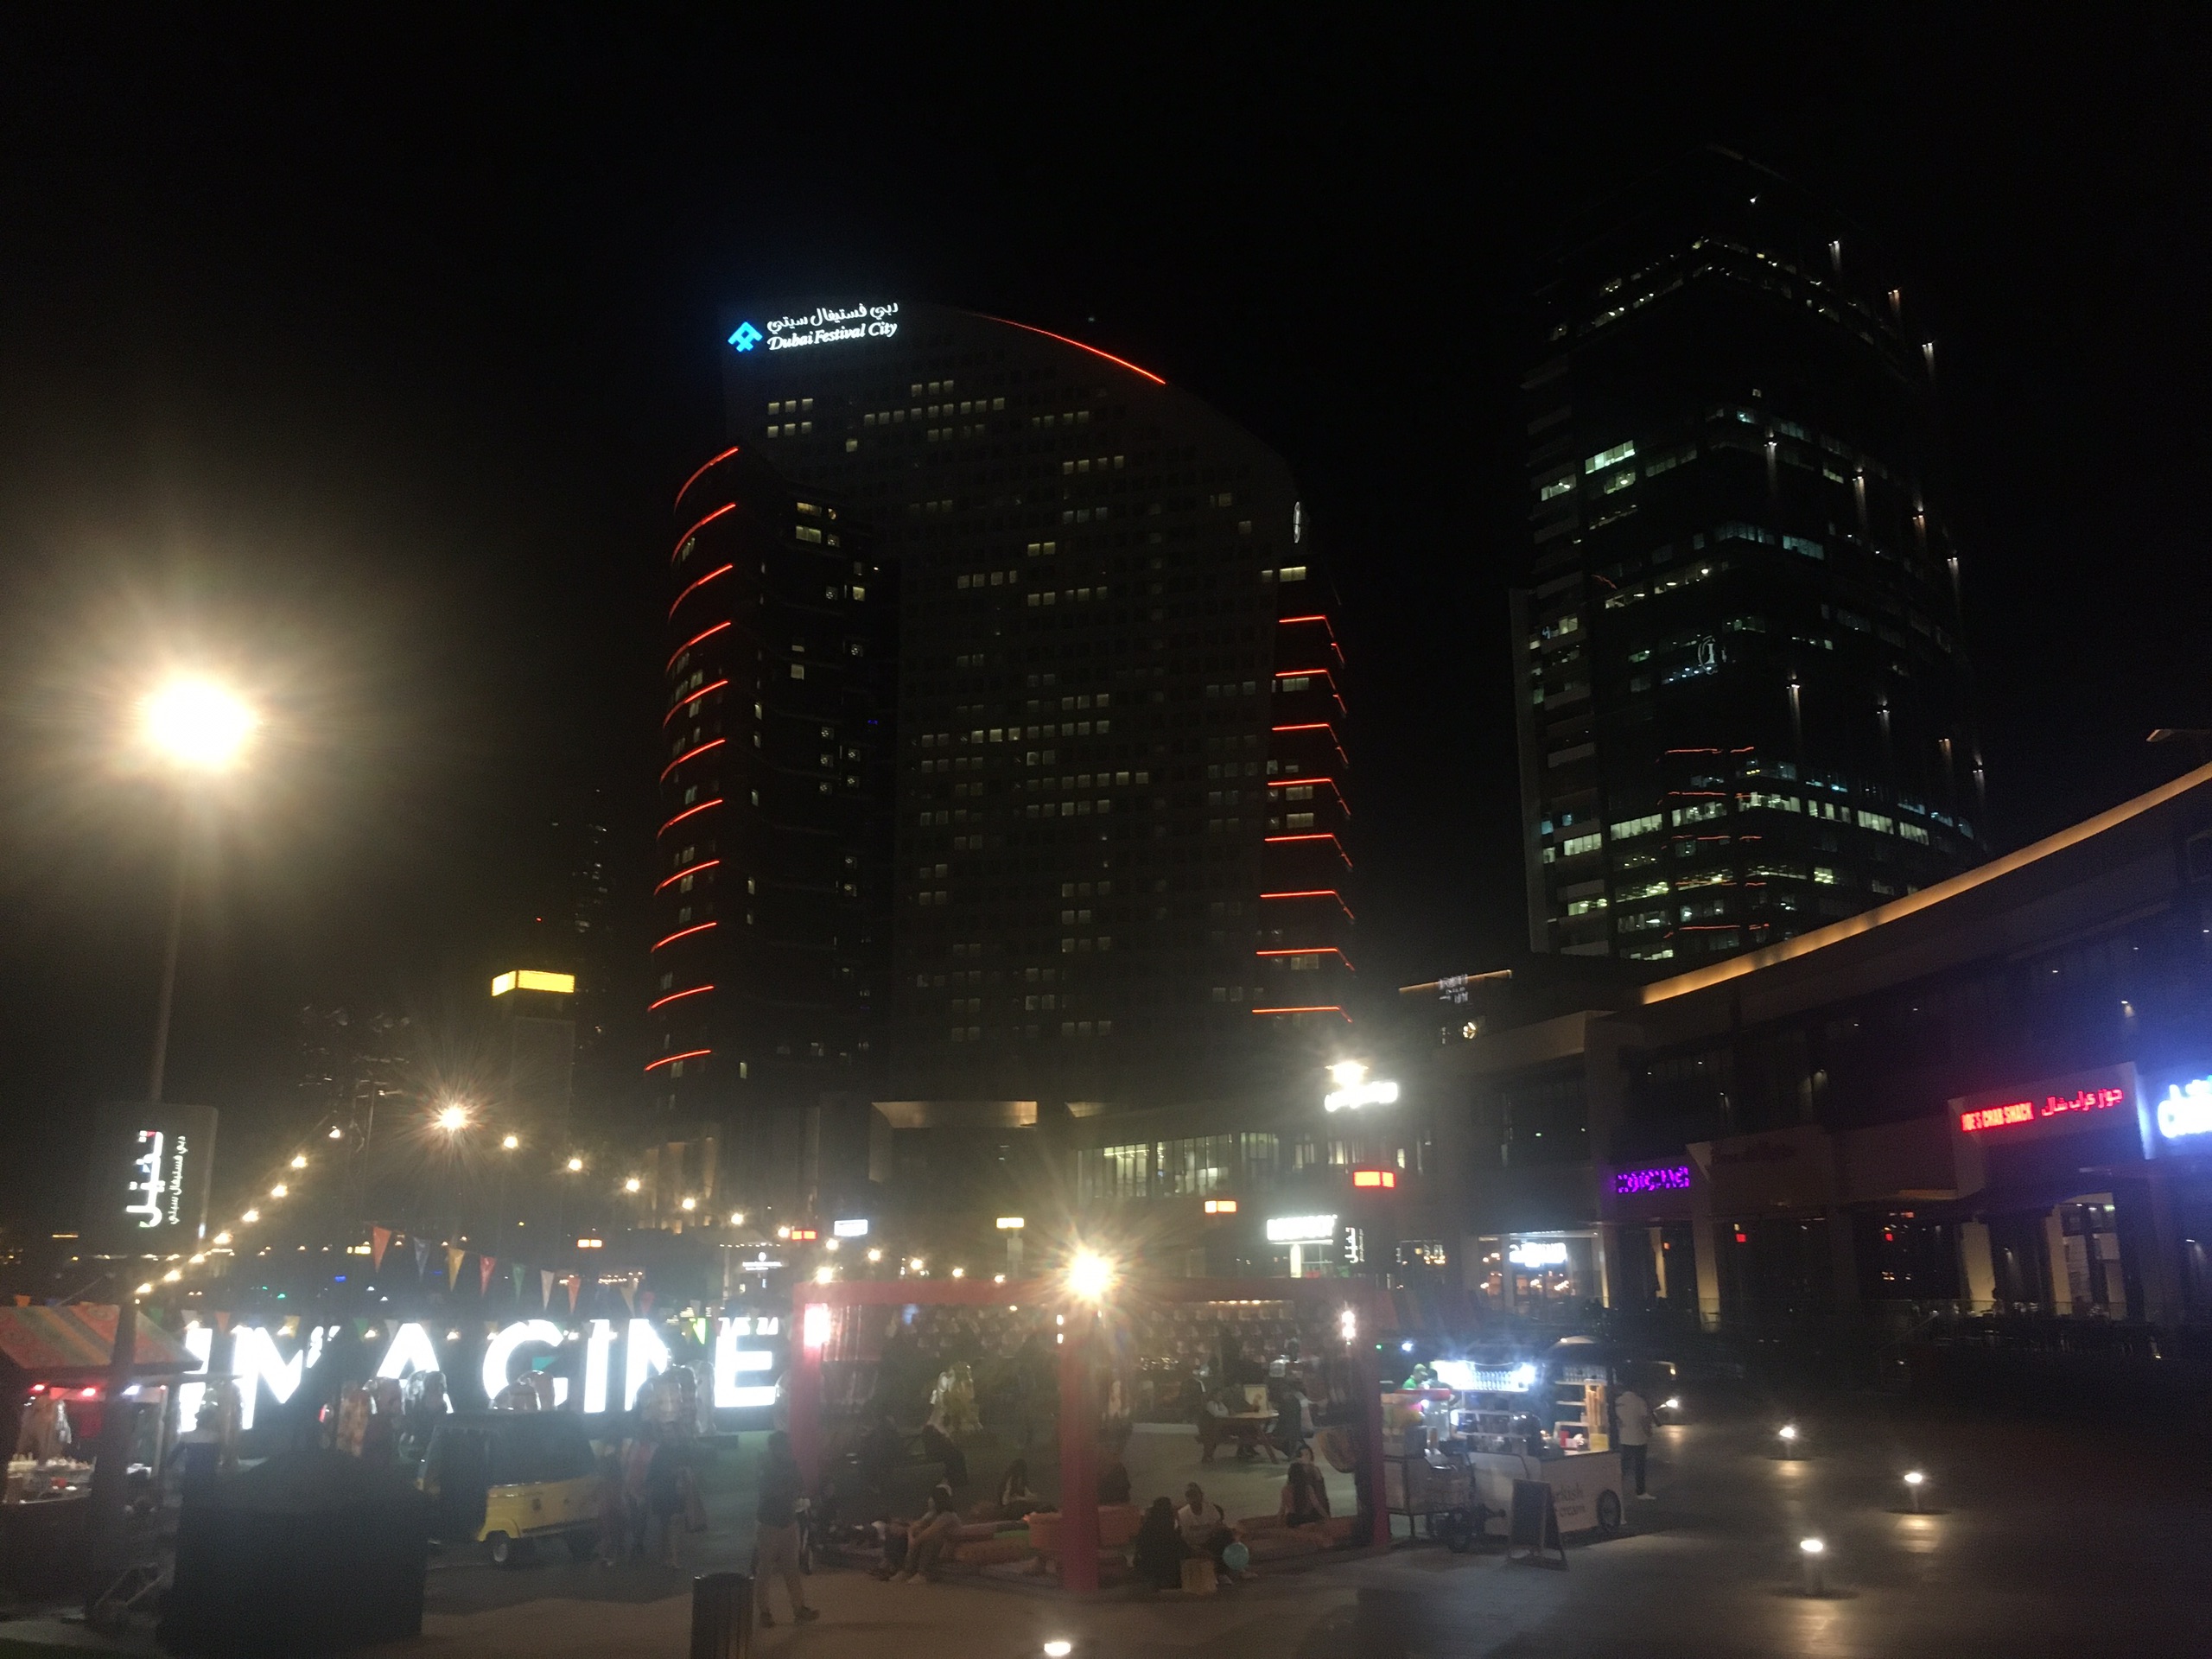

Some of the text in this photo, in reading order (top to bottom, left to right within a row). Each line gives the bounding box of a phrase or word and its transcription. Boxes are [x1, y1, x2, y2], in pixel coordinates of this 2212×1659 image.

[766, 302, 899, 334] دبي فستيفال سيتي
[766, 321, 898, 350] Dubai Festival City
